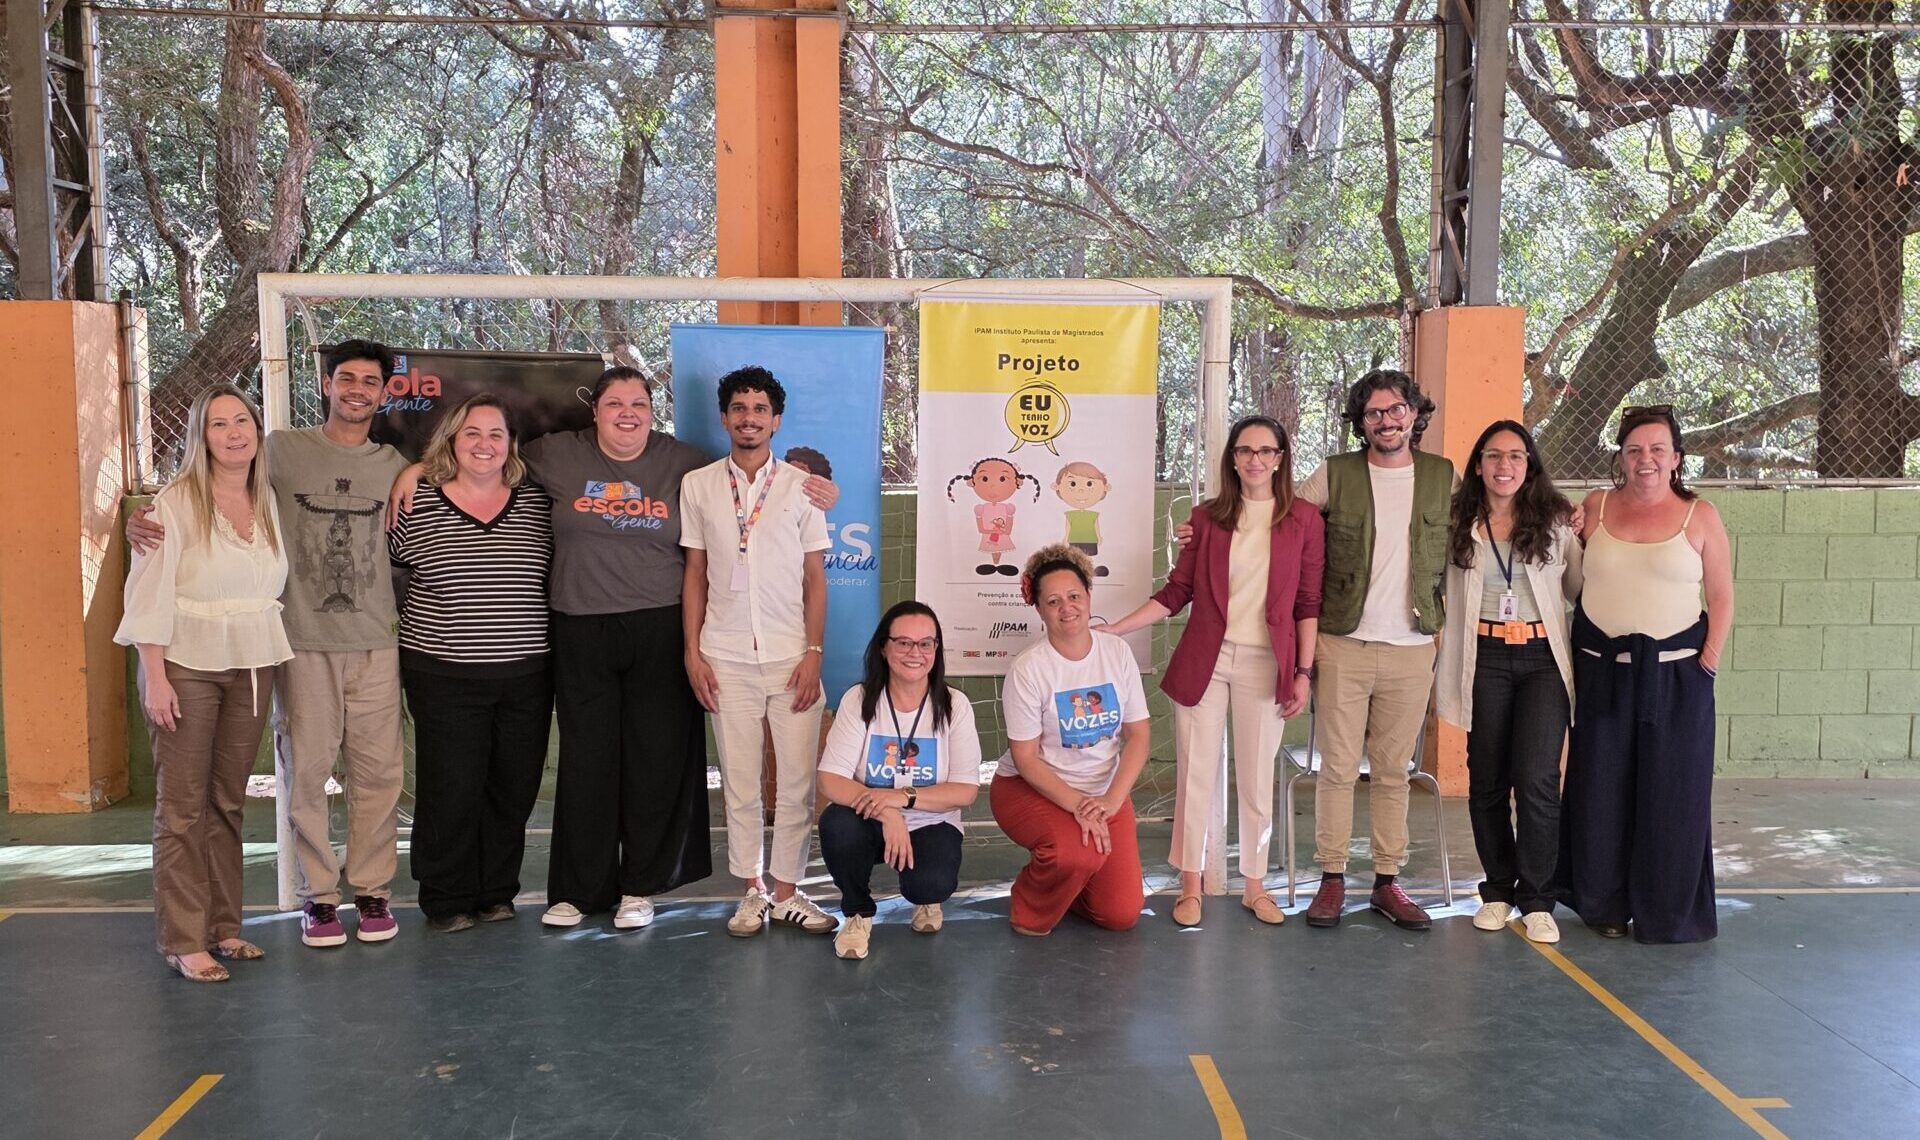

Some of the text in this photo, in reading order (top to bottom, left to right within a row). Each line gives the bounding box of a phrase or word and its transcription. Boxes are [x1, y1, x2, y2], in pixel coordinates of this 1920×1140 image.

[1062, 329, 1104, 337] Magistrados
[998, 353, 1080, 375] Projeto
[387, 368, 442, 397] ola
[1019, 395, 1051, 411] EU
[1020, 424, 1049, 436] VOZ
[573, 496, 669, 519] escola
[611, 513, 663, 532] Gente
[823, 552, 879, 571] ncia
[1059, 710, 1119, 732] VOZES
